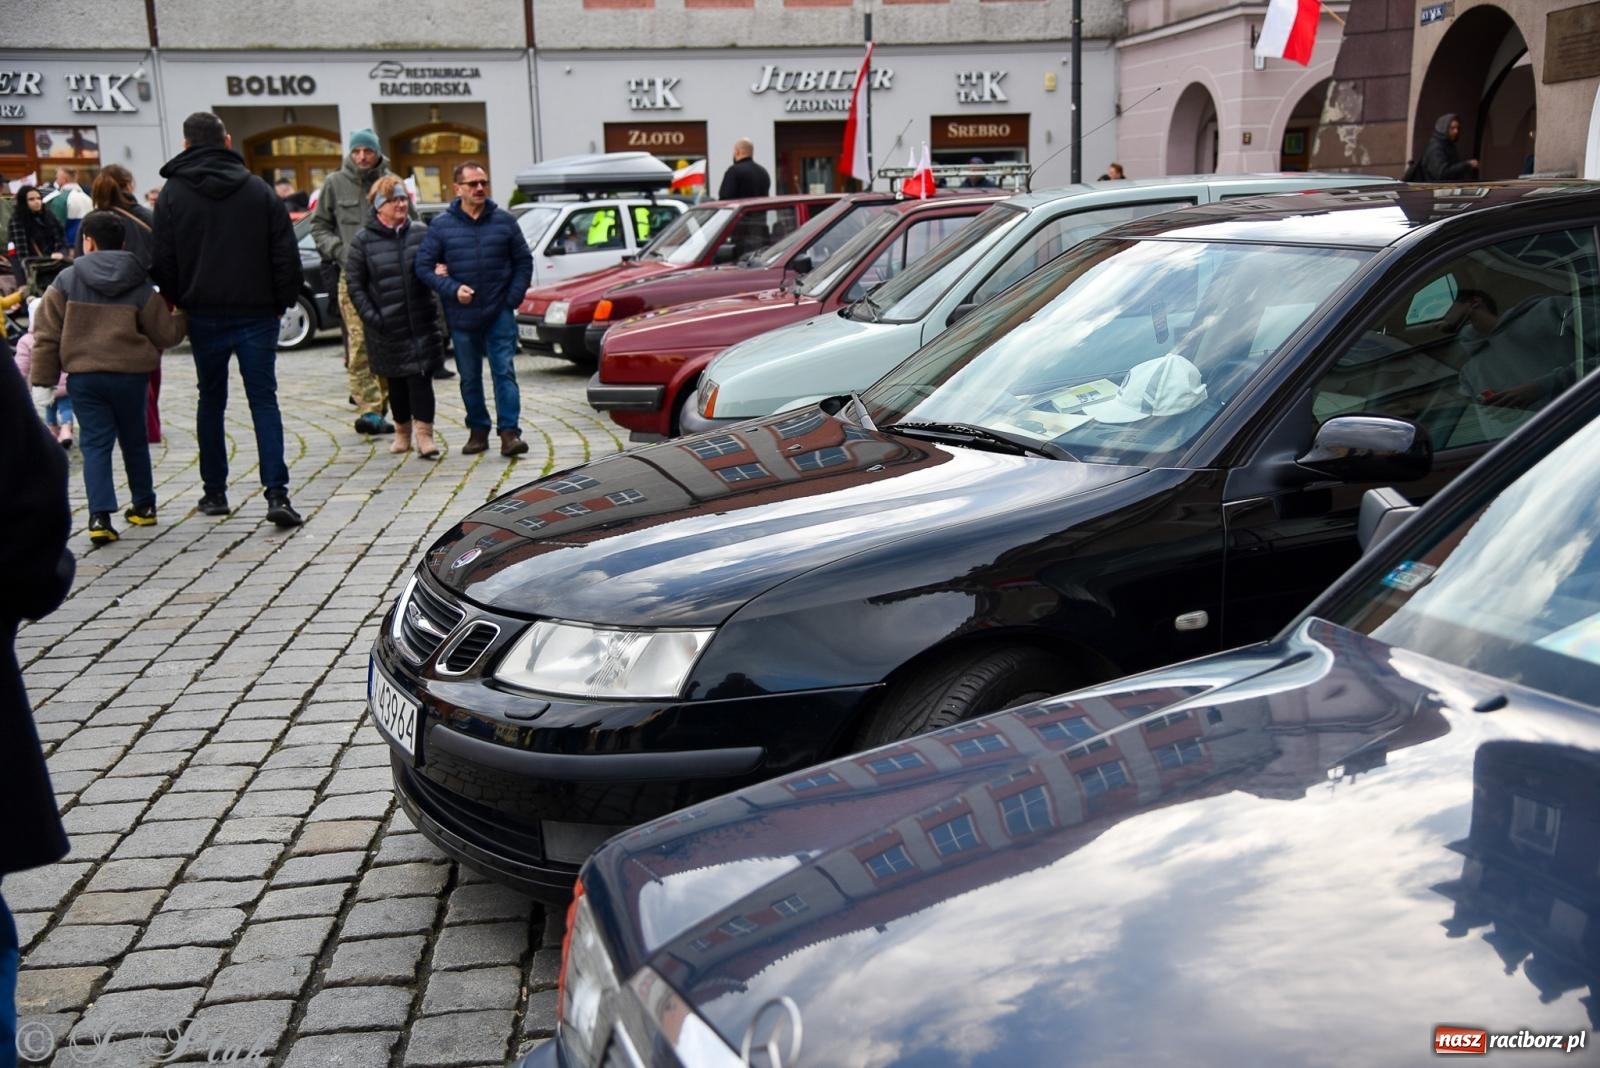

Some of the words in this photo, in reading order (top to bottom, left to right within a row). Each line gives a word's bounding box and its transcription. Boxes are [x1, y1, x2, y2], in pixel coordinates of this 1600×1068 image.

[405, 67, 481, 79] RESTAURACJA
[751, 65, 894, 93] JUBILR
[226, 75, 316, 96] BOLKO
[380, 82, 472, 96] RACIBORSKA
[947, 122, 1011, 138] SREBRO
[379, 682, 415, 750] 43964
